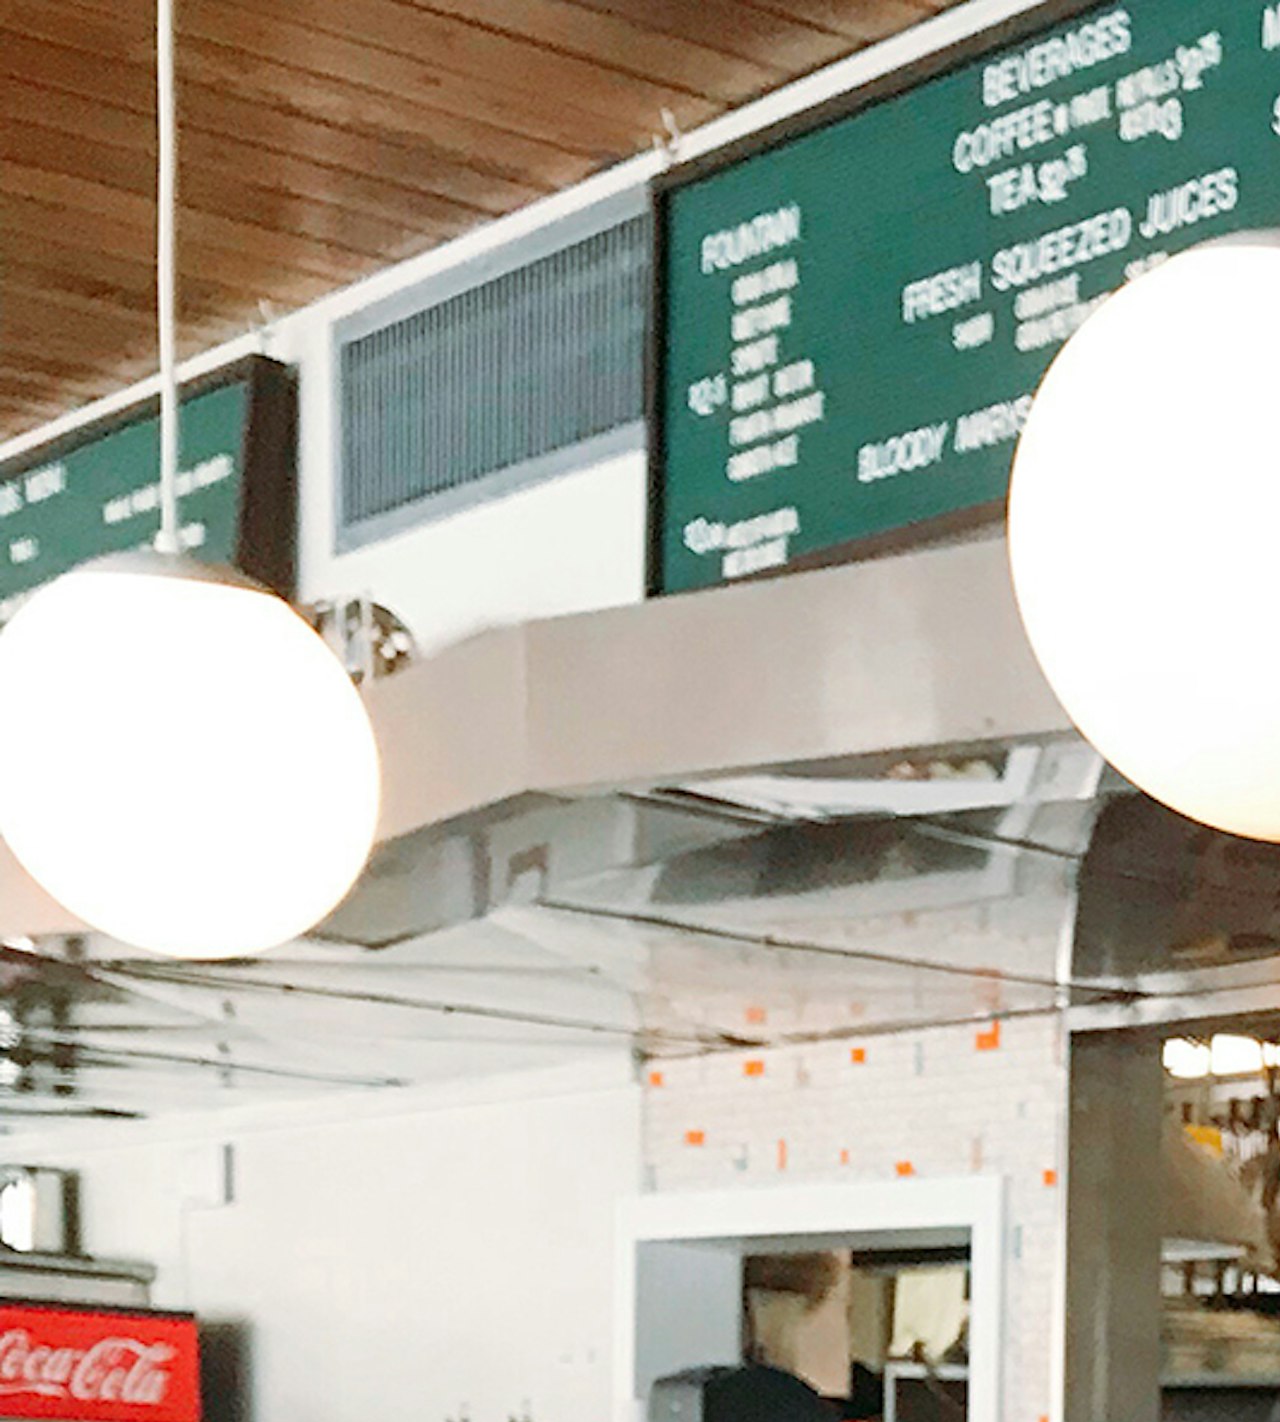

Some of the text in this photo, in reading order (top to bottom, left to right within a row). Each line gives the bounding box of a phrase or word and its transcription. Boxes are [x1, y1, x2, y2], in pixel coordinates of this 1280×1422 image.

[982, 9, 1132, 107] BEVERAGES
[953, 99, 1054, 174] COFFEE
[902, 260, 983, 325] FRESH
[990, 206, 1133, 293] SQUEEZED
[1138, 167, 1240, 240] JUICES
[857, 421, 949, 482] BLOODY
